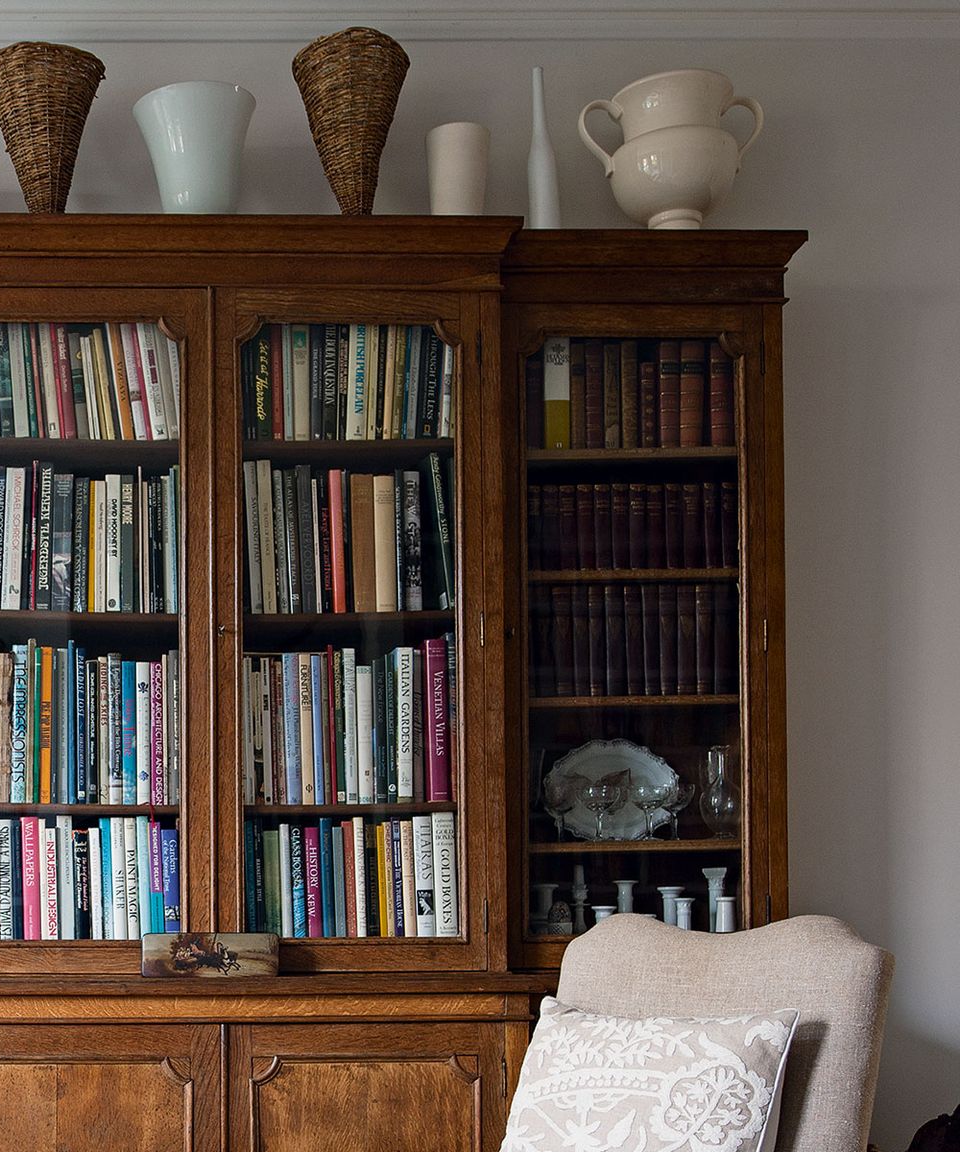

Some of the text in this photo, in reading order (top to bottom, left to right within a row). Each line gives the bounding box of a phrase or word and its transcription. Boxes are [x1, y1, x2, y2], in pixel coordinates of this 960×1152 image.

[354, 324, 366, 415] BRITISH PORCELAIN
[428, 334, 438, 378] THROUGH
[116, 360, 126, 402] VIZCAYA
[323, 369, 337, 405] QUESTION
[428, 379, 437, 397] THE
[426, 399, 435, 420] LENS
[12, 474, 23, 512] MICHAEL
[122, 483, 132, 525] HENRY MOORE
[301, 501, 311, 523] AXEL
[11, 514, 21, 552] SCHRECK
[110, 498, 118, 558] DAVID HOCKNEY BY
[440, 519, 449, 544] STONE
[113, 667, 121, 689] English
[300, 664, 309, 706] FURNITURE
[401, 654, 411, 754] ITALIAN GARDENS
[433, 670, 446, 757] VENETIAN VILLAS
[10, 687, 28, 784] IMPRESSIONISTS
[154, 663, 164, 805] CHICAGO ARCHITECTURE AND DESIGN
[25, 821, 35, 887] WALLPAPERS
[168, 839, 178, 874] Gardens
[309, 847, 319, 888] HISTORY
[420, 823, 432, 881] TIARAS
[46, 841, 57, 936] INDUSTRIAL DESIGN
[115, 870, 124, 909] SHAKER
[127, 849, 138, 923] PAINT MAGIC
[307, 893, 316, 918] KEW
[440, 848, 453, 925] GOLD BOXES
[0, 907, 12, 940] ESTIVAL
